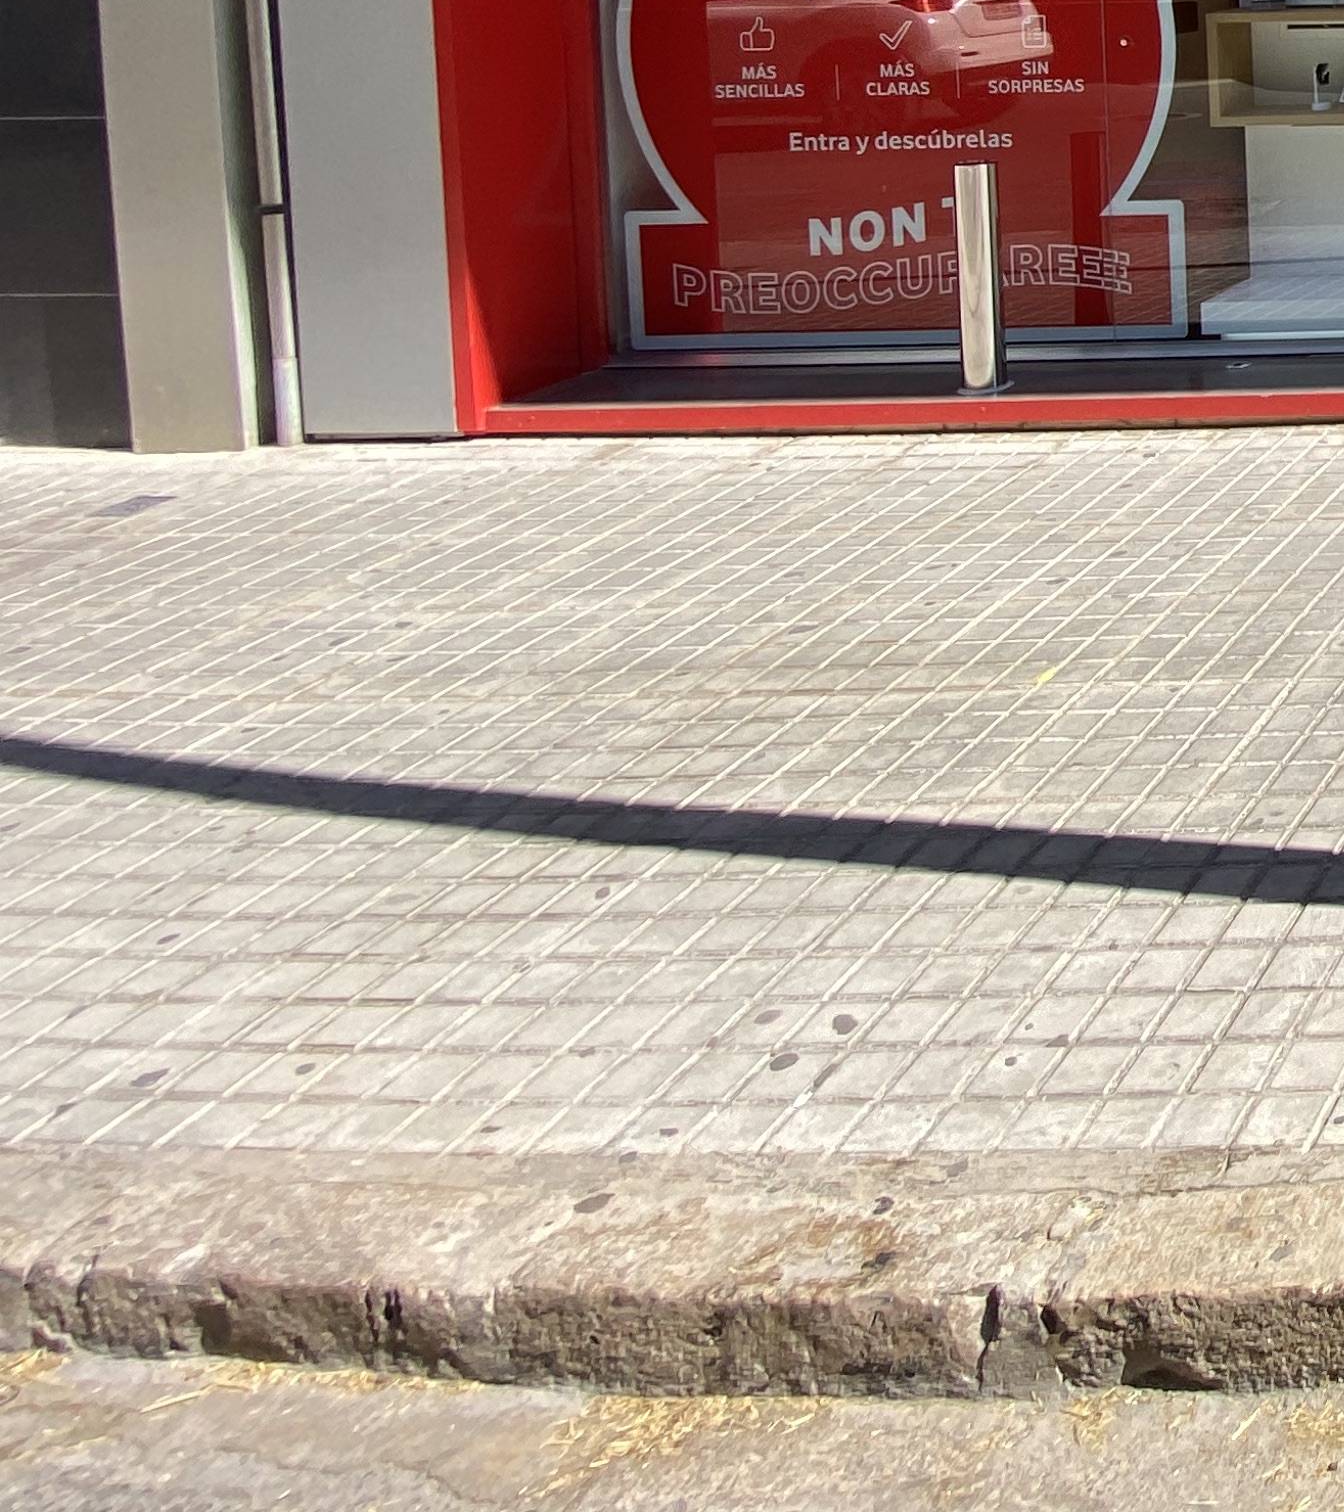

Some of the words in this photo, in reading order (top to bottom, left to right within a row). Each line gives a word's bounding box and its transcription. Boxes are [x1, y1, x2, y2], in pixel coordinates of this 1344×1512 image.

[741, 61, 777, 80] MÁS
[879, 60, 915, 78] MÁS
[1021, 60, 1049, 75] SIN
[715, 82, 805, 99] SENCILLAS
[866, 80, 930, 97] CLARAS
[987, 78, 1085, 94] SORPRESAS
[789, 133, 849, 153] Entra
[855, 136, 870, 155] y
[874, 129, 1013, 152] descúbrelas
[808, 202, 927, 257] NON
